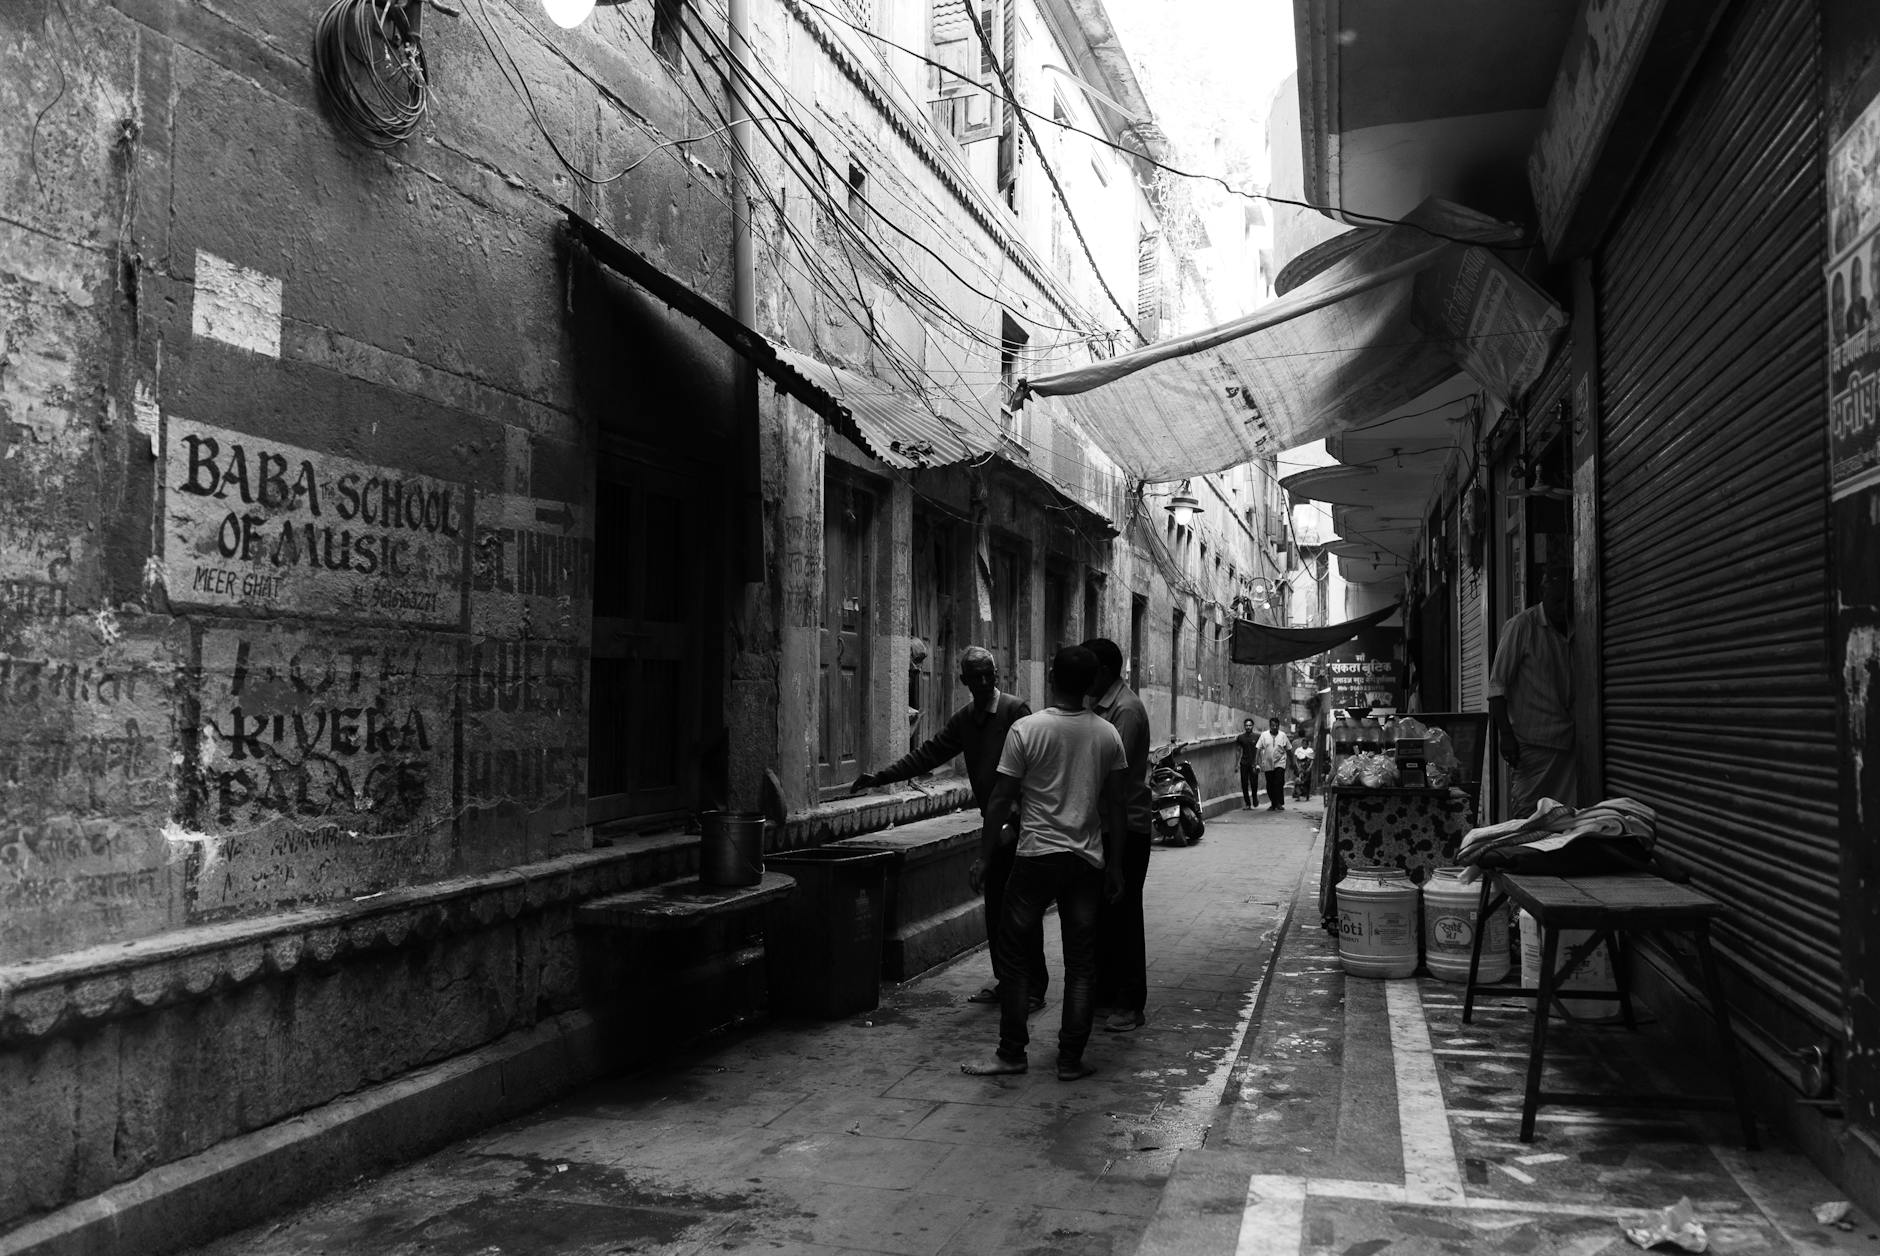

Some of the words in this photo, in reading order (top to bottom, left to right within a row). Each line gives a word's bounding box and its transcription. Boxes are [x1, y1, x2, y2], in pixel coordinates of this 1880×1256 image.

[178, 434, 321, 517] BABA
[336, 473, 460, 537] SCHOOL
[218, 511, 268, 561] OF
[271, 519, 411, 578] MUSIC
[193, 565, 237, 596] MEER
[243, 573, 284, 598] GHAT
